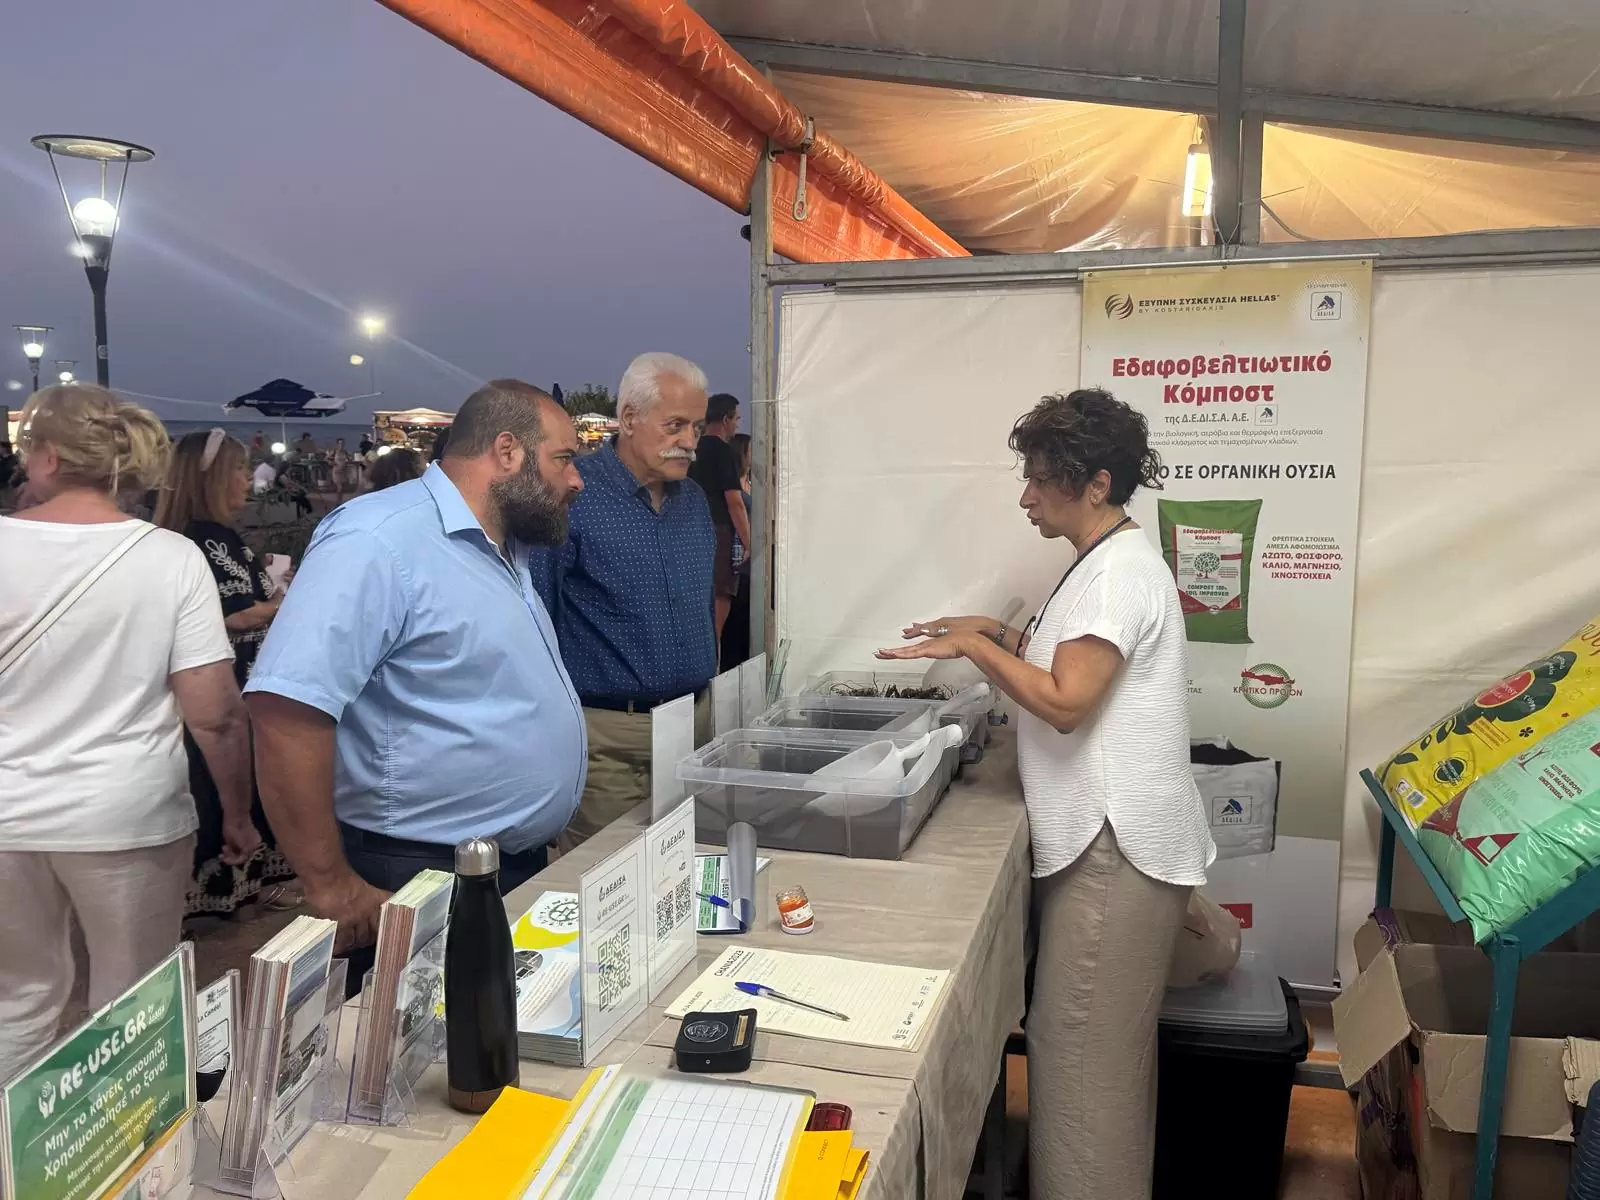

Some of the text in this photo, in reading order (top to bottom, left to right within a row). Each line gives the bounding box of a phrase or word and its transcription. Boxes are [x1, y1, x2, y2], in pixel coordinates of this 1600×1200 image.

[1139, 299, 1176, 307] ΕΞΥΠΝΗ
[1179, 296, 1237, 306] ΣΥΣΚΕΥΑΣΙΑ
[1112, 350, 1332, 379] Εδαφοβελτιωτικό
[1164, 382, 1275, 406] Κόμποστ
[1164, 415, 1180, 425] της
[1231, 412, 1250, 422] Α.Ε.
[1174, 465, 1194, 479] ΣΕ
[1198, 464, 1280, 479] ΟΡΓΑΝΙΚΗ
[1285, 464, 1336, 478] ΟΥΣΙΑ
[1262, 552, 1343, 560] ΑΖΩΤΟ, ΦΩΣΦΟΡΟ,
[1262, 562, 1342, 571] ΚΑΛΙΟ, ΜΑΓΝΗΣΙΟ,
[1271, 572, 1332, 580] ΙΧΝΟΣΤΟΙΧΕΙΑ
[44, 1126, 70, 1157] Μην
[73, 1112, 87, 1131] το
[90, 1078, 123, 1114] κάνεις
[125, 1038, 166, 1083] σκουπίδι
[44, 1091, 128, 1182] Χρησιμοποίησέ
[130, 1083, 142, 1101] το
[143, 1053, 169, 1088] ξανά!
